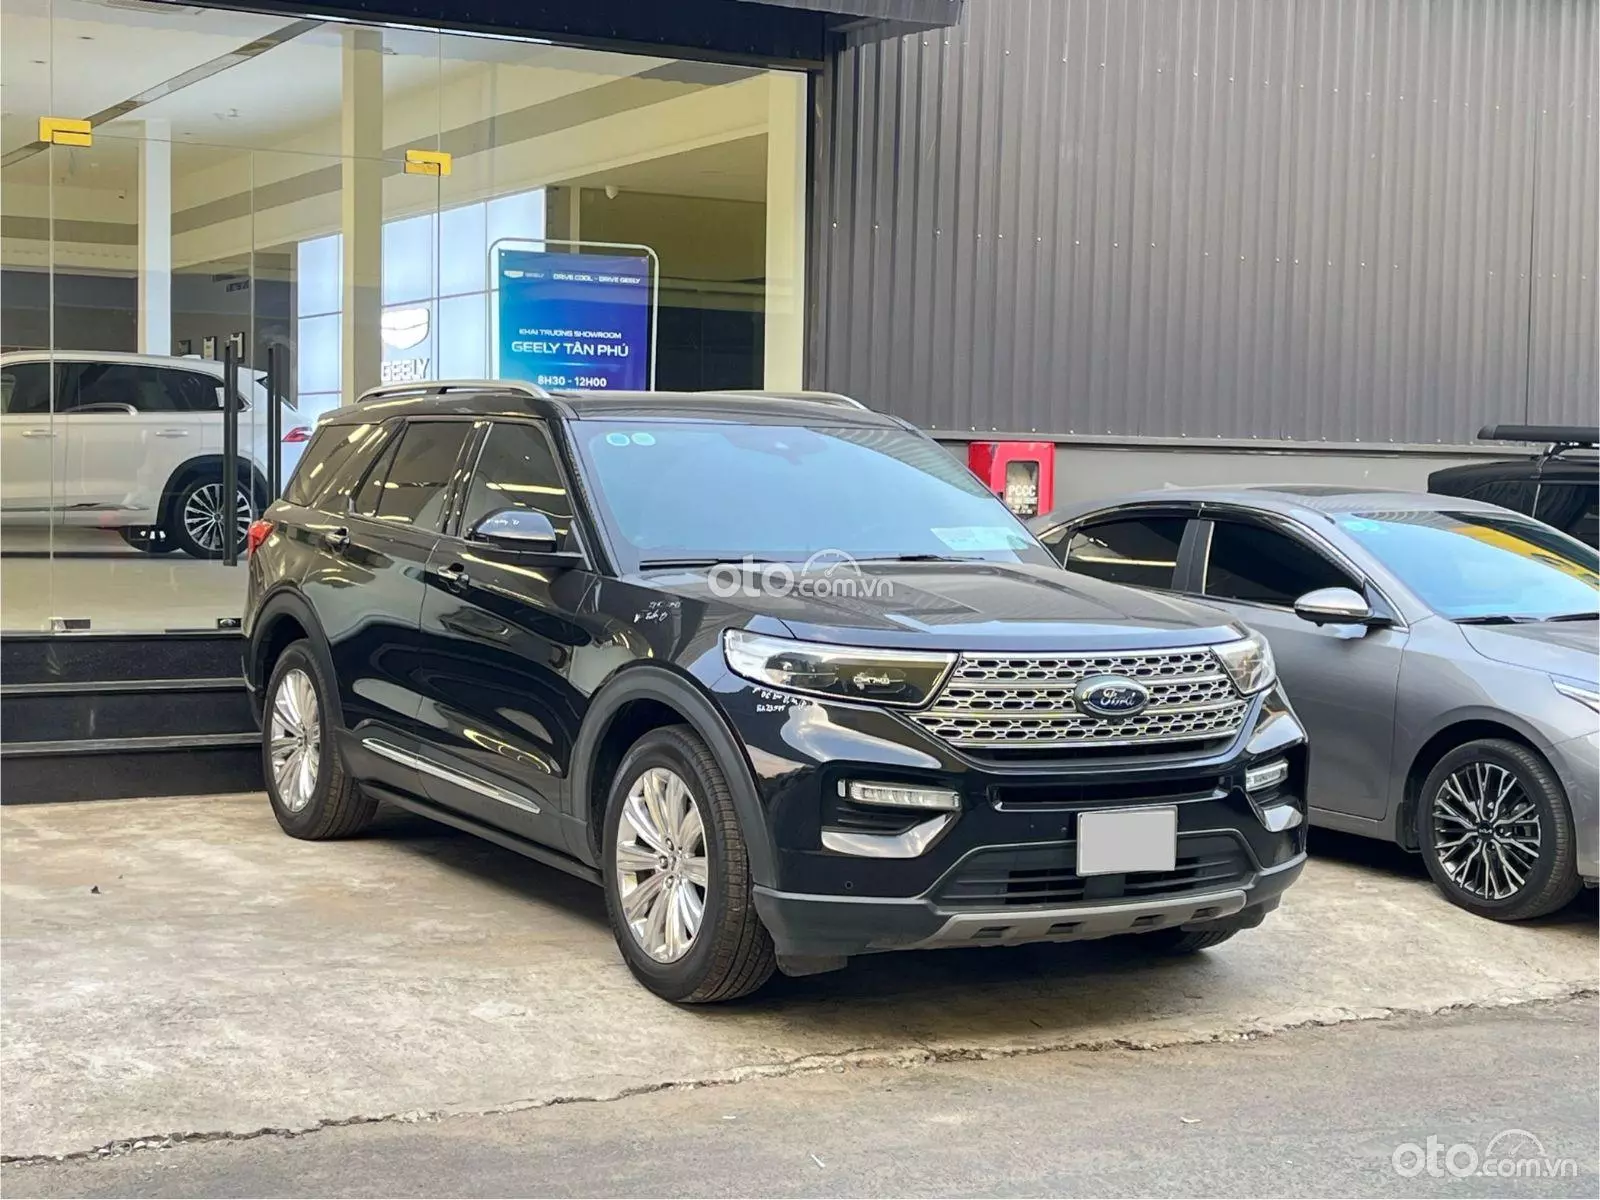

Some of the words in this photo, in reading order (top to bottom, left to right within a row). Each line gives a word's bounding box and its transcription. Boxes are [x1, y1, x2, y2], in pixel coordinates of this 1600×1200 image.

[553, 273, 574, 281] DRIVE
[574, 274, 593, 282] COOL
[599, 275, 619, 283] DRIVE
[519, 328, 539, 336] KHAI
[573, 331, 622, 339] SHOWROOM
[511, 341, 560, 354] GEELY
[563, 341, 594, 356] TÂN
[597, 343, 629, 357] PHÚ
[381, 358, 430, 382] GEELY
[537, 374, 566, 386] 8H30
[574, 376, 607, 388] 12H00
[1008, 484, 1036, 497] PCCC
[1100, 688, 1136, 706] Ford
